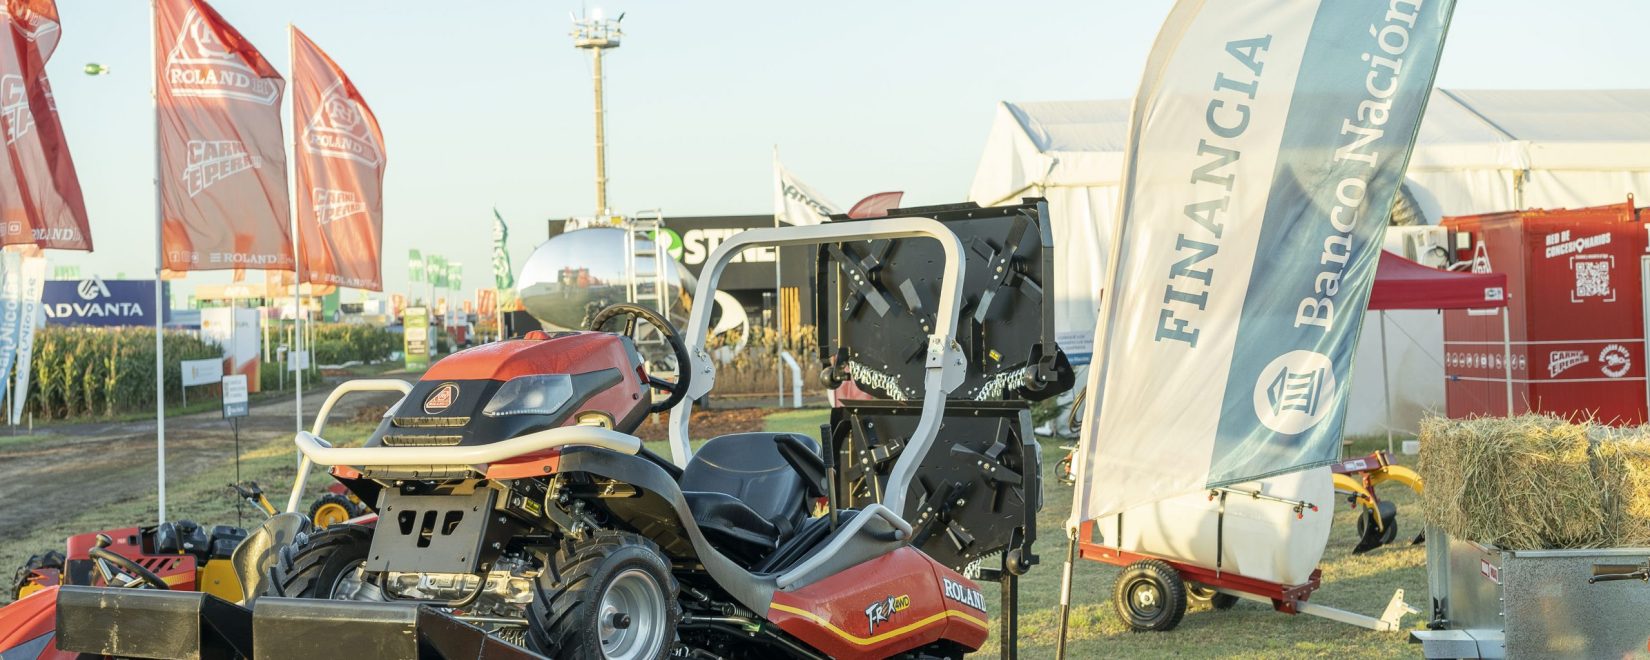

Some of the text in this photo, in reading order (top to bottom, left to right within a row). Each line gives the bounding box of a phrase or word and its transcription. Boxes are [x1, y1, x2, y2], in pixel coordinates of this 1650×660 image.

[171, 68, 250, 88] ROLAND
[187, 140, 247, 168] CARN
[1294, 0, 1420, 332] Banco Nación
[1155, 34, 1272, 348] FINANCIA
[683, 228, 776, 265] STNE
[1545, 229, 1570, 246] RED DE
[223, 252, 277, 265] ROLAND
[43, 302, 144, 318] ADVANTA
[943, 578, 987, 613] ROLAND
